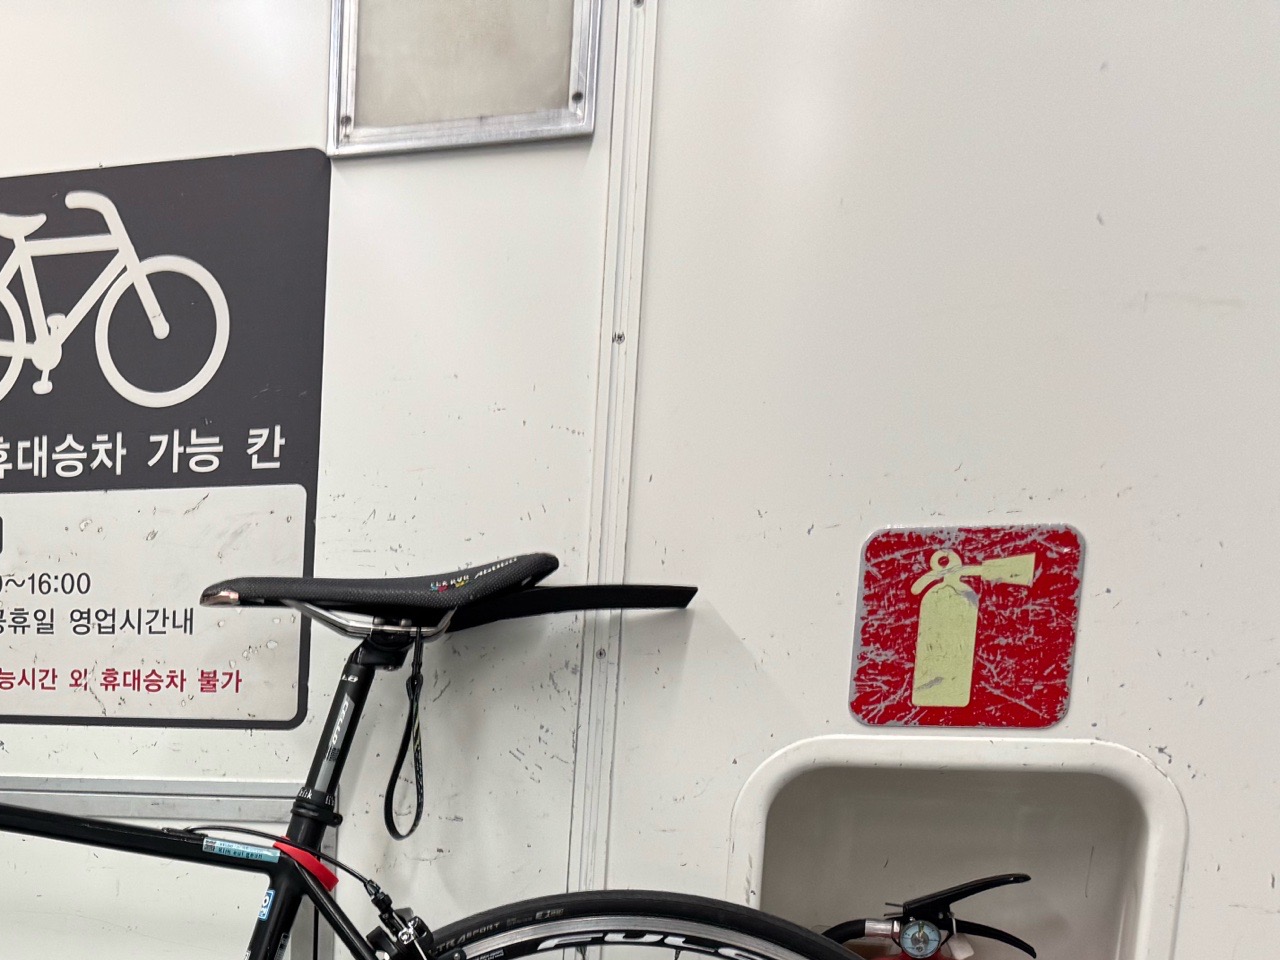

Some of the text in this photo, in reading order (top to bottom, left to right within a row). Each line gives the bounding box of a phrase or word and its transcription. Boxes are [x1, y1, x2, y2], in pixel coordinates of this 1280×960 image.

[148, 428, 224, 473] 가능
[246, 425, 286, 470] 칸
[69, 607, 195, 635] 영업시간내
[69, 668, 88, 690] 외
[99, 668, 187, 692] 휴대승차
[197, 669, 243, 693] 불가
